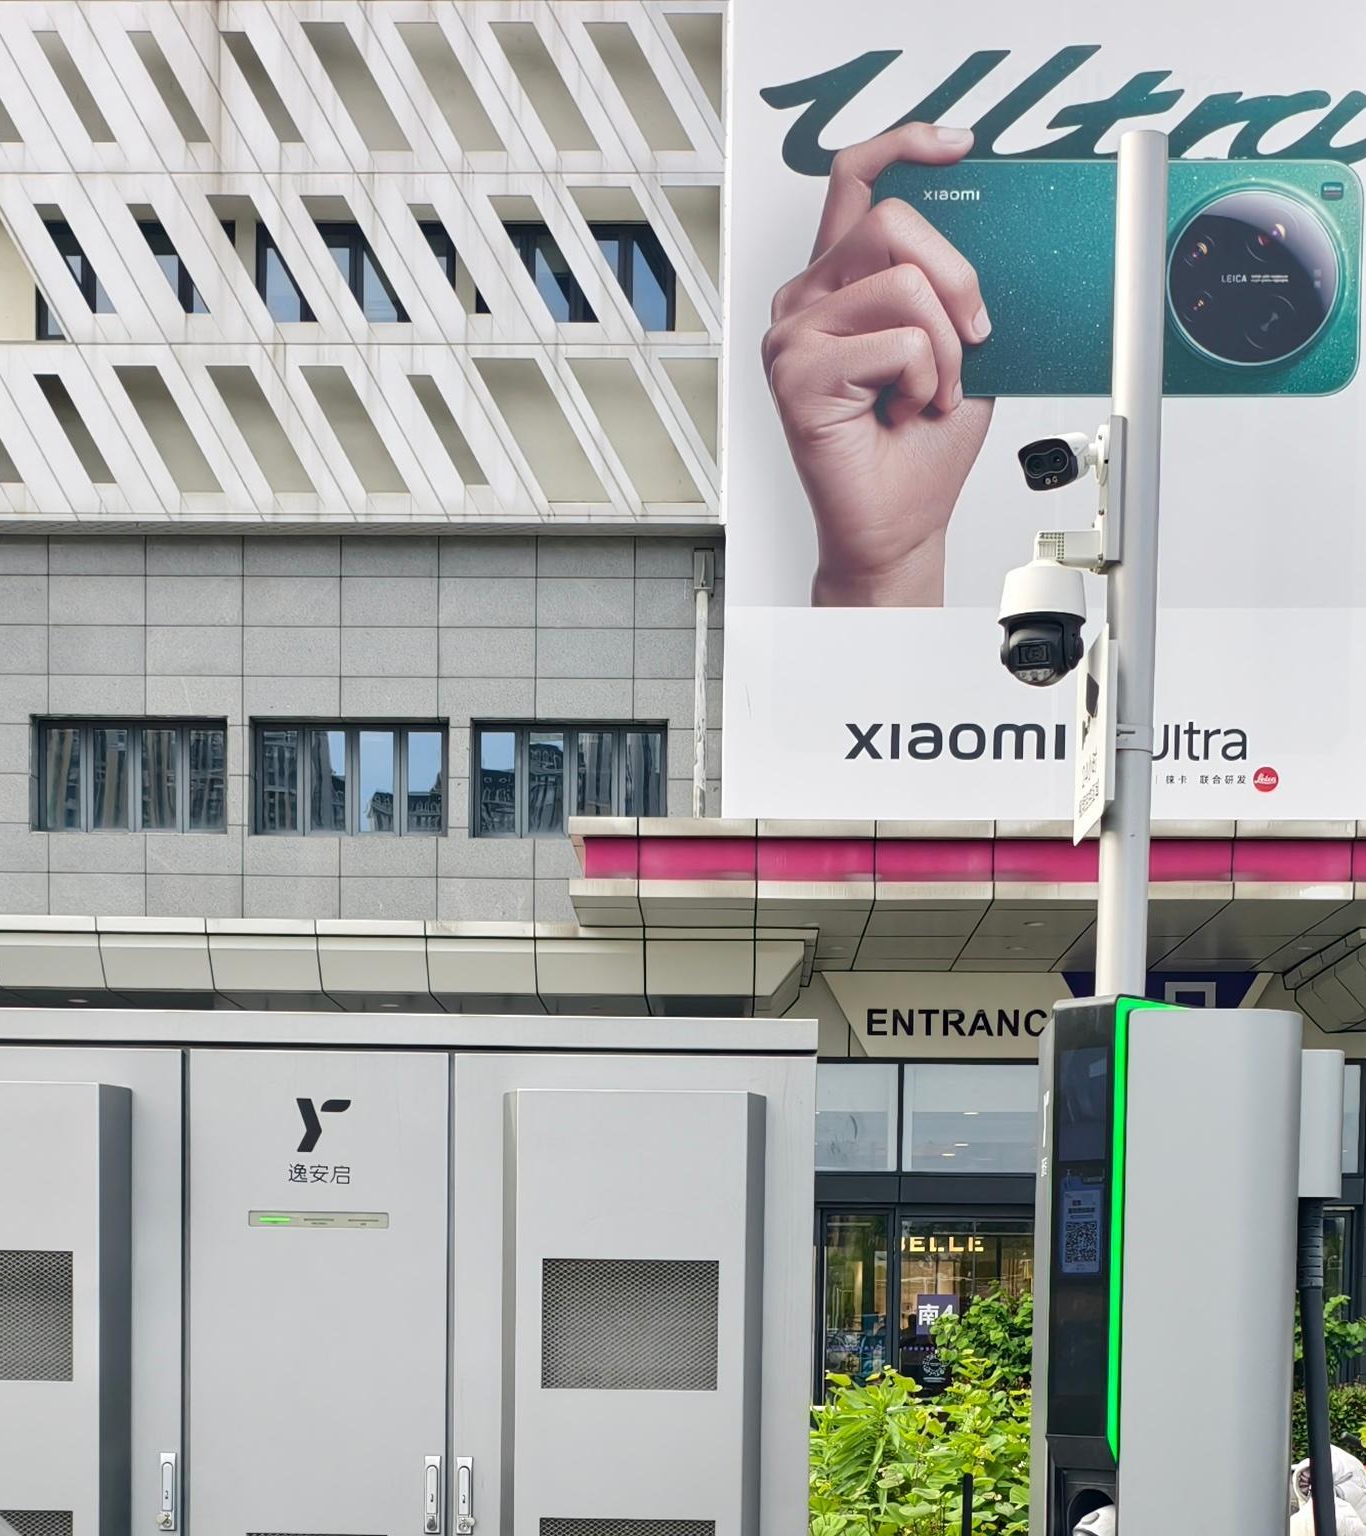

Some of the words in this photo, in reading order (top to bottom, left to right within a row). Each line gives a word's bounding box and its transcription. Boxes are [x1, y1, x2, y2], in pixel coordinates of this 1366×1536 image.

[923, 187, 980, 202] xiaomi
[1221, 274, 1247, 283] LEICA
[844, 722, 1066, 761] xiaomi
[288, 1163, 351, 1185] 逸安启
